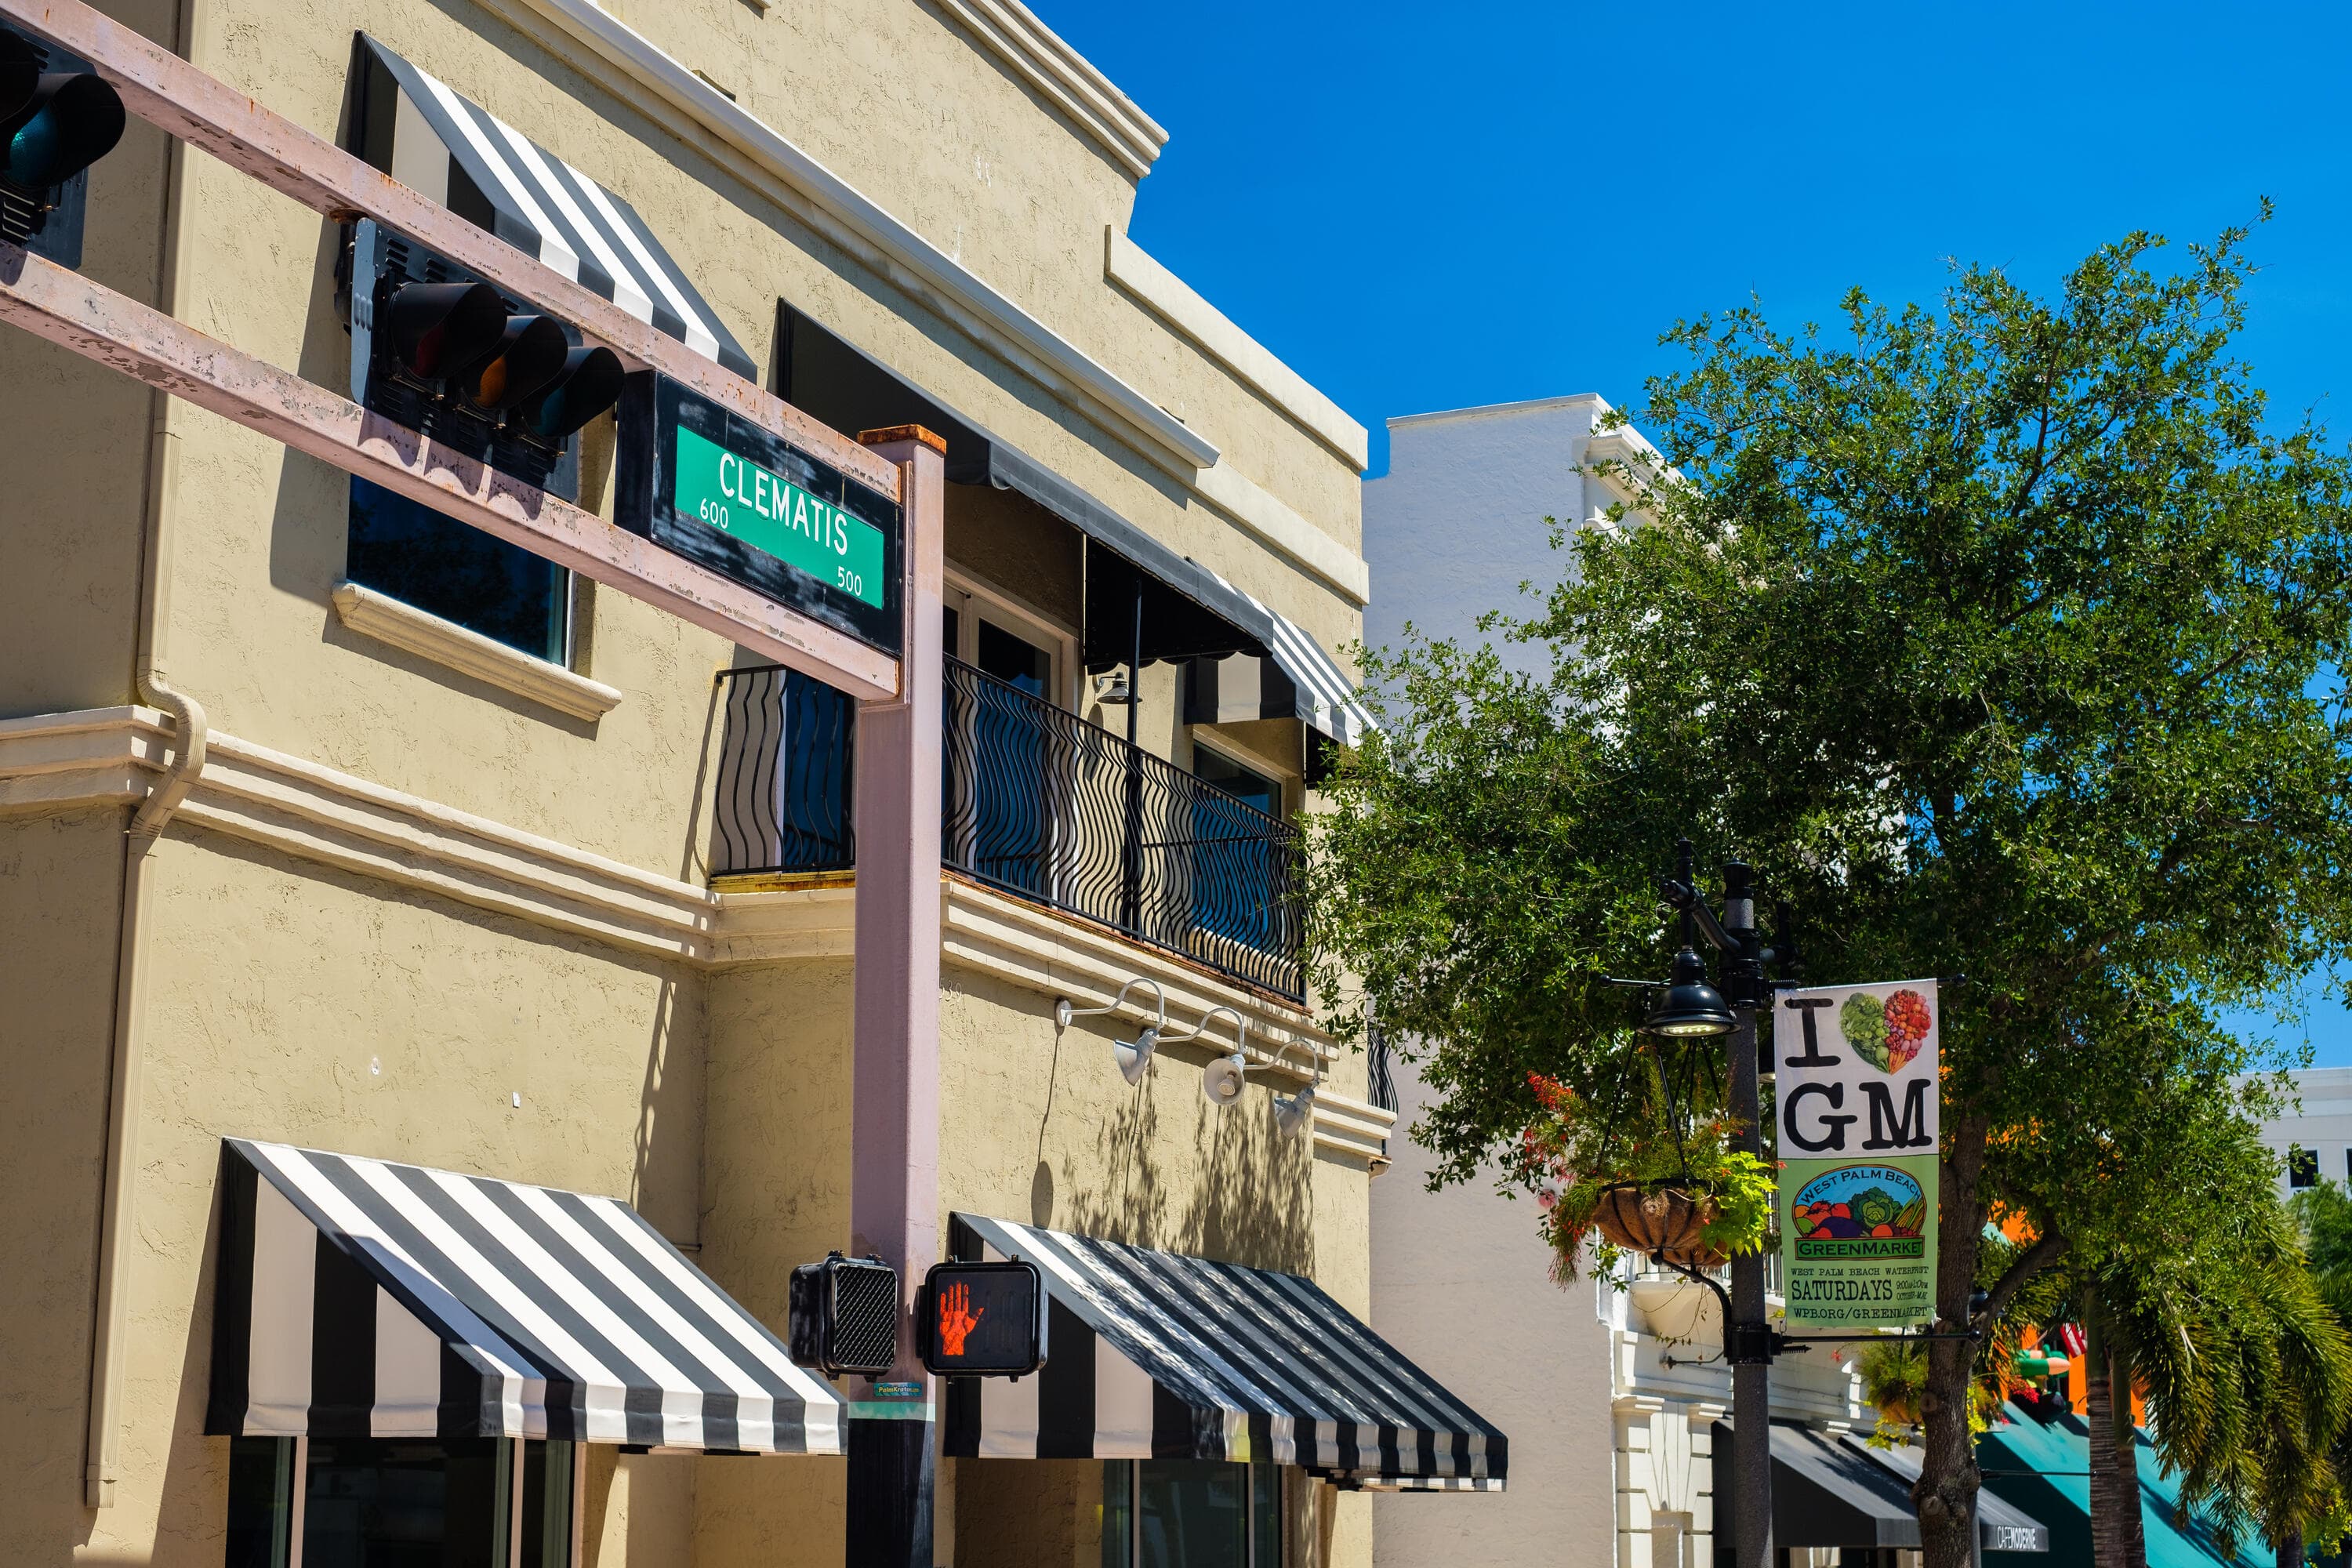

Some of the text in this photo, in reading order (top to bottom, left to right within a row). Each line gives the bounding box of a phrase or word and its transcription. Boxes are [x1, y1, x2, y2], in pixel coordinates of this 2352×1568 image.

[699, 497, 729, 529] 600
[719, 452, 848, 556] CLEMATIS
[837, 565, 862, 597] 500
[1784, 998, 1841, 1067] I
[1784, 1079, 1933, 1152] GM
[1801, 1170, 1922, 1204] WEST PALM BEACH
[1798, 1241, 1922, 1255] GREENMARKET
[1819, 1268, 1844, 1276] PALM
[1849, 1267, 1880, 1276] BEACH
[1791, 1279, 1893, 1301] SATURDAYS
